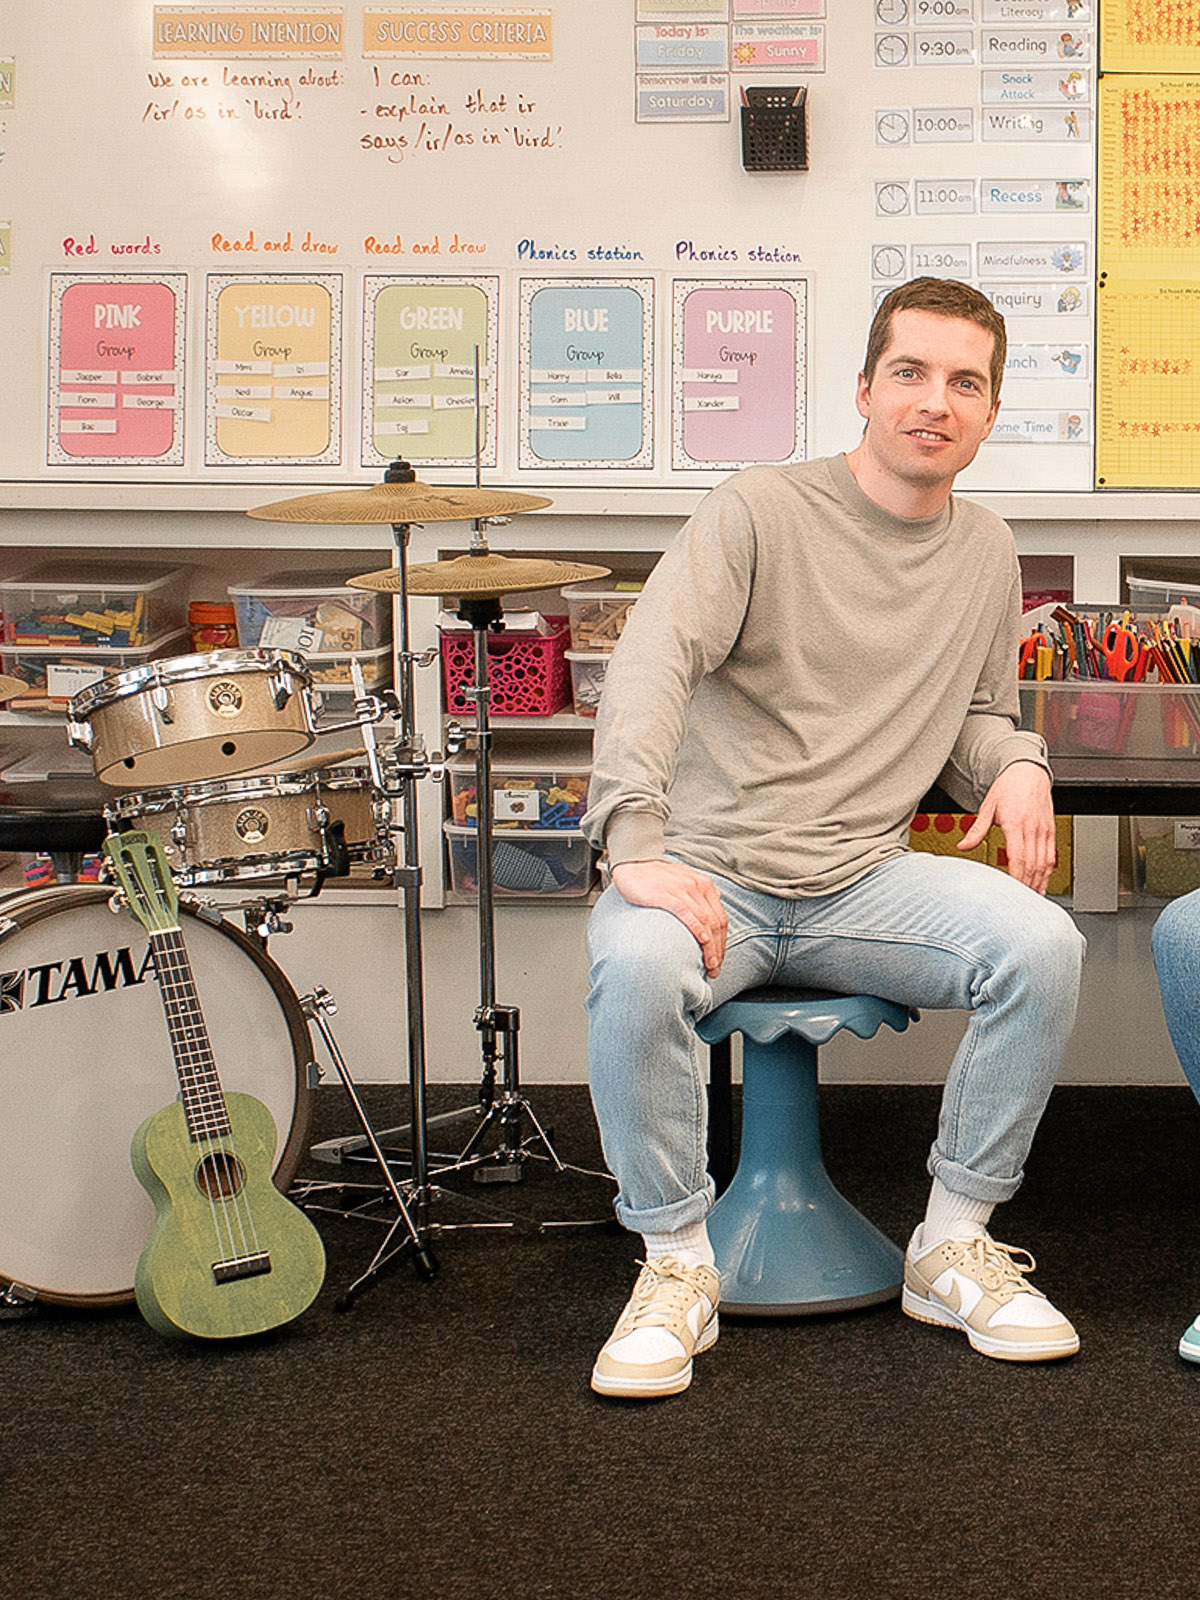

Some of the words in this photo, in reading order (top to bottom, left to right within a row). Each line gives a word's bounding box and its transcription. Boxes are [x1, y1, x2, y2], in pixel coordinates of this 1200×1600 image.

[1001, 7, 1043, 19] Literacy
[157, 21, 245, 44] LEARNING
[251, 21, 342, 44] INTENTION
[376, 20, 463, 43] SUCCESS
[469, 22, 547, 44] CRITERIA
[656, 27, 692, 40] Today
[735, 25, 754, 36] The
[758, 25, 805, 36] weather
[657, 45, 705, 59] Friday
[767, 45, 807, 58] Sunny
[920, 41, 969, 56] 9:30am
[989, 37, 1047, 54] Reading
[181, 76, 210, 88] are
[639, 76, 690, 86] Tomorrow
[691, 76, 707, 86] will
[1002, 73, 1033, 85] Snack
[649, 95, 715, 109] Saturday
[1001, 89, 1036, 100] Attack
[218, 102, 240, 120] in
[375, 94, 450, 122] explain
[465, 88, 508, 114] that
[518, 94, 537, 114] ir
[917, 118, 970, 131] 10:00am
[989, 115, 1044, 133] Writng
[360, 133, 409, 164] says
[454, 132, 475, 146] as
[482, 127, 501, 146] in
[920, 189, 972, 203] 11:00am
[990, 187, 1043, 203] Recess
[62, 234, 99, 257] Red
[111, 235, 161, 256] words
[211, 230, 259, 254] Read
[263, 231, 295, 254] and
[301, 231, 340, 255] draw
[363, 235, 406, 256] Read
[411, 235, 442, 256] and
[449, 233, 488, 256] draw
[517, 240, 577, 261] Phonics
[586, 245, 645, 262] station
[675, 241, 740, 261] Phonics
[749, 246, 803, 263] station
[916, 254, 968, 268] 11:30am
[984, 254, 1048, 266] Mindfulness
[989, 290, 1042, 309] Inquiry
[94, 303, 142, 329] PINK
[233, 304, 316, 329] YELLOW
[400, 306, 463, 331] GREEN
[564, 308, 609, 332] BLUE
[706, 309, 773, 334] PURPLE
[96, 340, 136, 360] Group
[253, 340, 293, 361] Group
[410, 342, 450, 363] Group
[566, 344, 605, 365] Group
[719, 345, 758, 366] Group
[994, 422, 1020, 434] ome
[1024, 420, 1053, 433] Time
[28, 942, 159, 1008] TAMA
